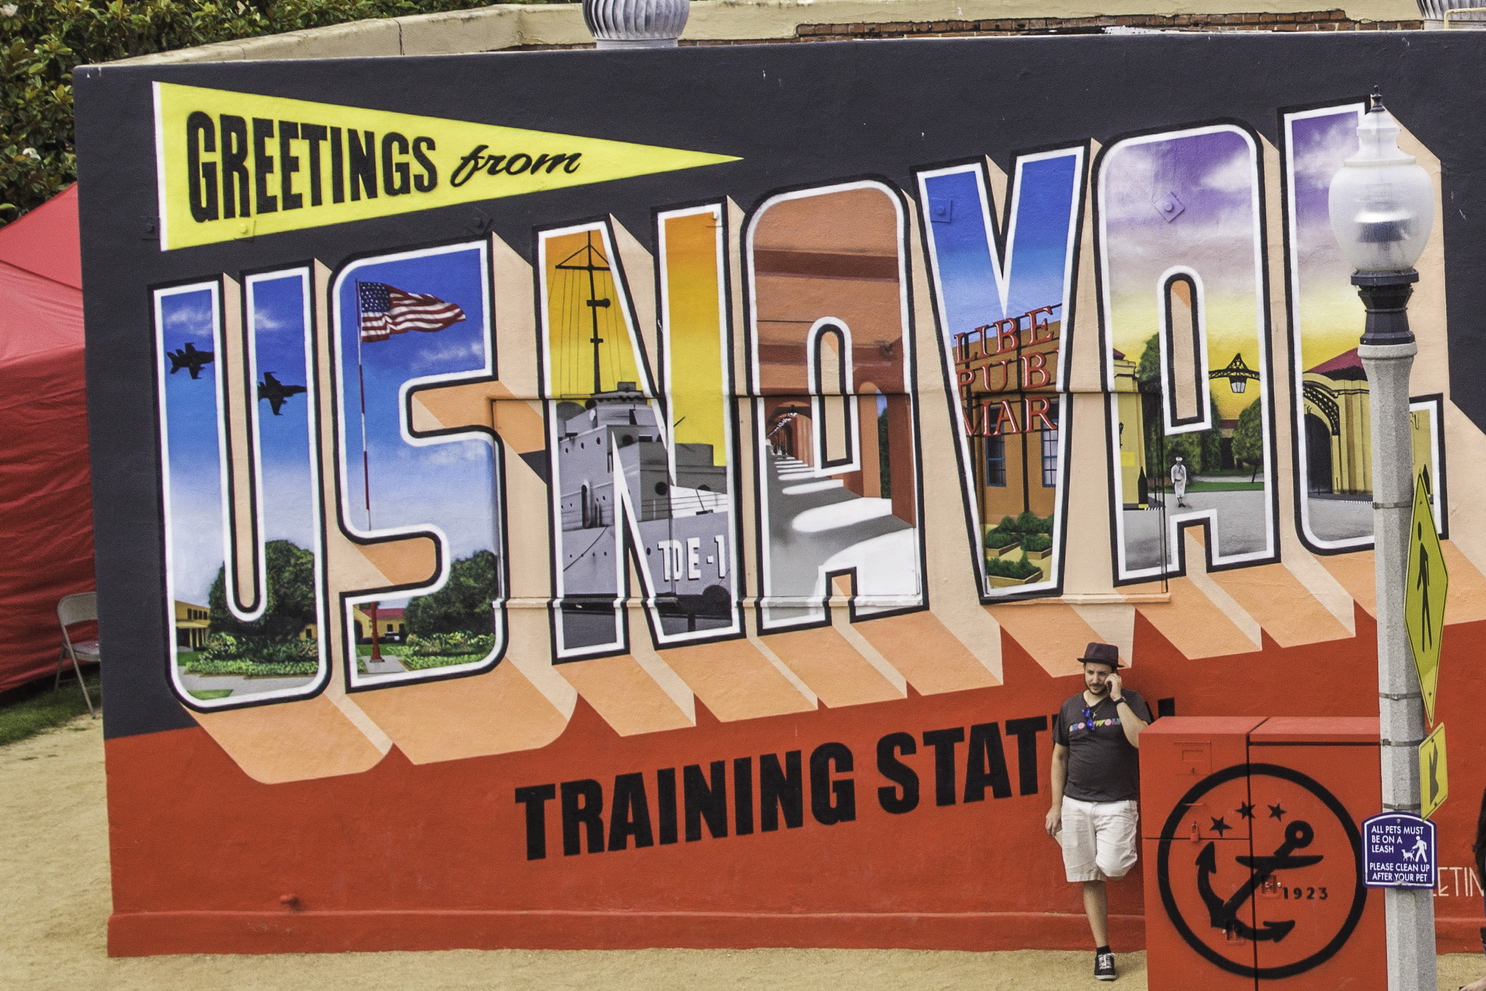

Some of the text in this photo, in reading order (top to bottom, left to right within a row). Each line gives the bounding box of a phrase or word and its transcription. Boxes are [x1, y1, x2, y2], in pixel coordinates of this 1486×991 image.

[186, 110, 582, 223] GREETINGS from
[953, 306, 1053, 364] LIBE
[956, 348, 1058, 400] PUB
[657, 535, 727, 581] TDE-1
[514, 741, 857, 861] TRAINING
[1371, 825, 1424, 835] ALL PETS MUST
[1371, 835, 1403, 844] BE ON A
[1371, 845, 1394, 853] LEASH
[1369, 862, 1430, 872] PLEASE CLEAN UP
[1372, 872, 1428, 882] AFTER YOUR PET
[1283, 886, 1329, 900] 1923
[1433, 867, 1484, 897] ETIN
